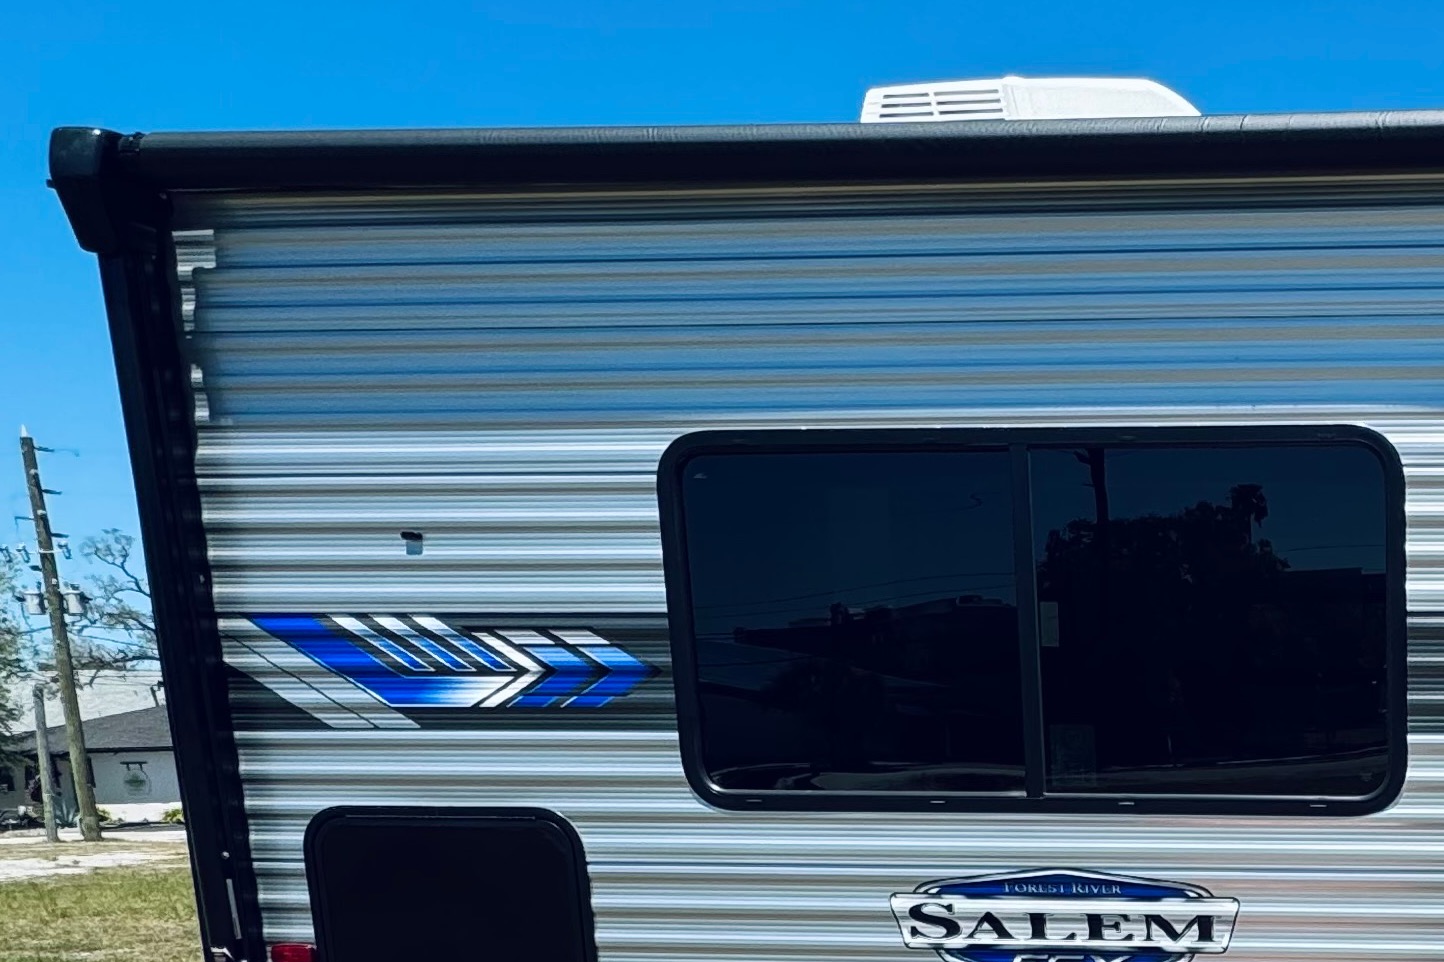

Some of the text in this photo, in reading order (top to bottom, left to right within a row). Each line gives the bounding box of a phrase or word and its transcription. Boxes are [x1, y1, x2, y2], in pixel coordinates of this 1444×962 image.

[1003, 882, 1122, 895] FOREST RIVER
[908, 903, 1220, 944] SALEM
